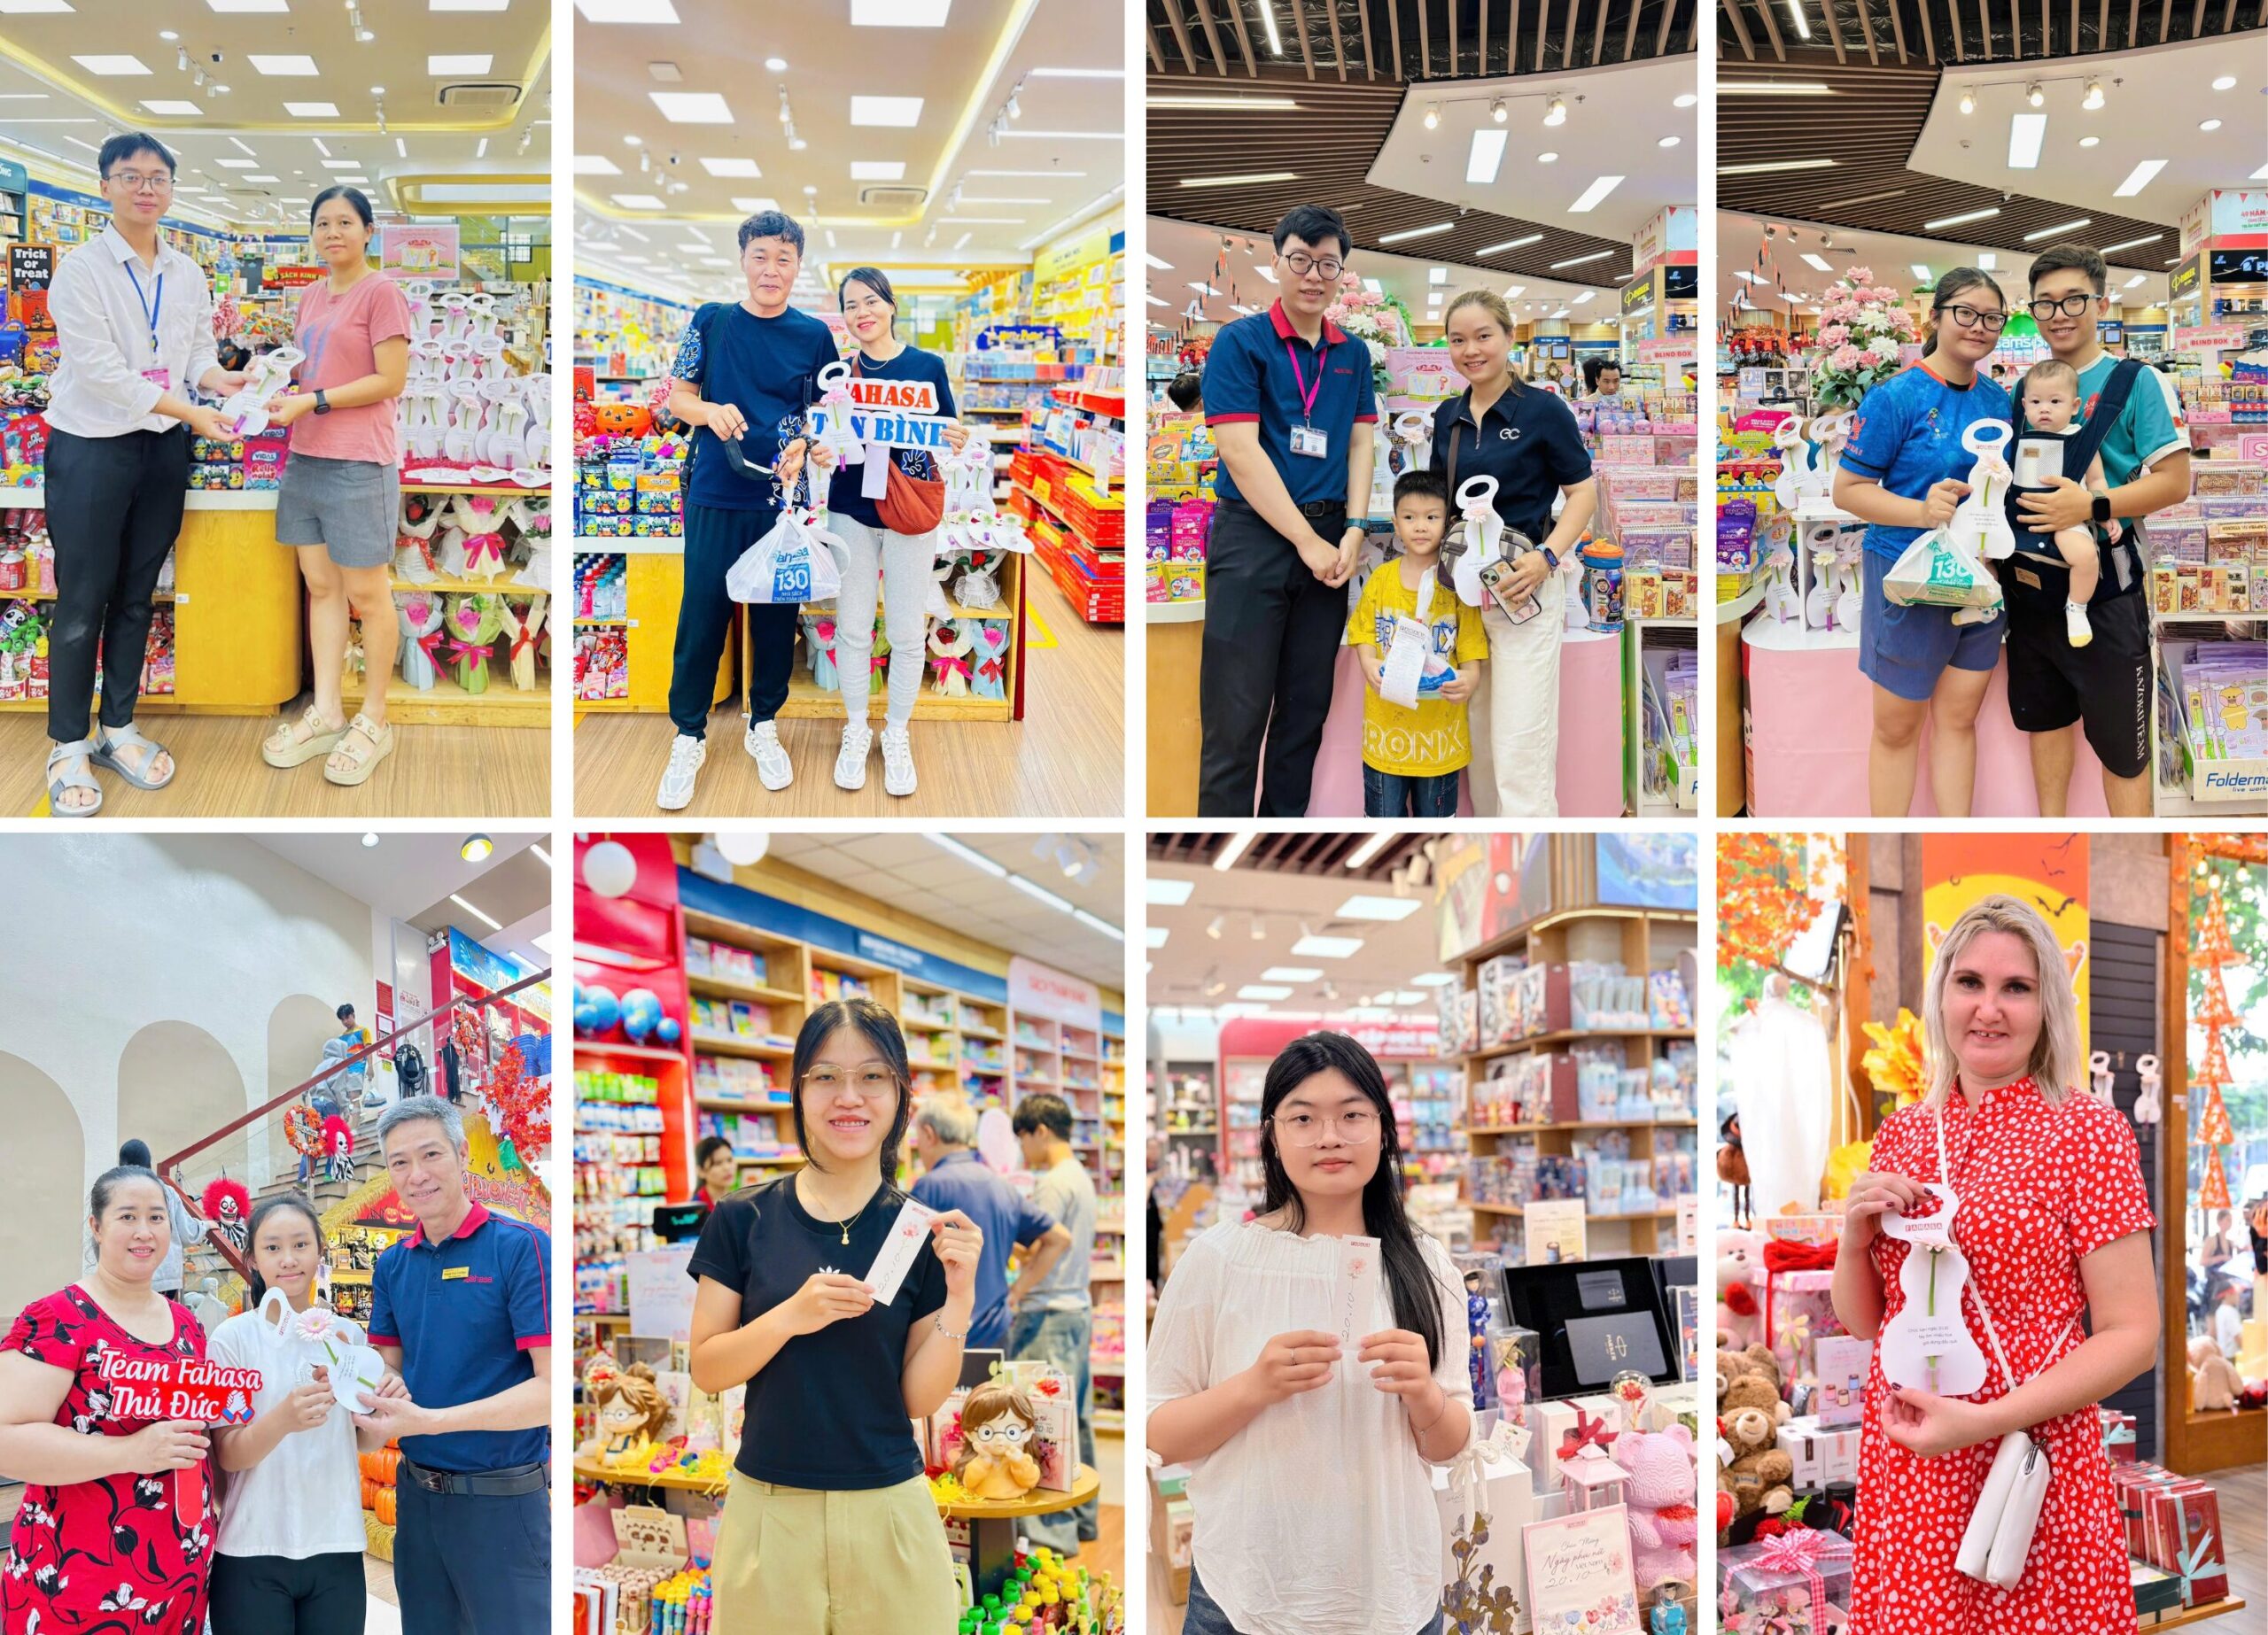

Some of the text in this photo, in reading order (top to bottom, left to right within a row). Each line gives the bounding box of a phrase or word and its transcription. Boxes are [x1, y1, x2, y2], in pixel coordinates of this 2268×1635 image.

[15, 248, 47, 259] Trick
[24, 260, 38, 268] or
[14, 268, 49, 279] Treat
[846, 383, 932, 408] AHASA
[812, 411, 866, 439] TN
[777, 569, 809, 591] 130
[2136, 666, 2146, 761] KAZOKU TEAM
[1906, 1222, 1942, 1232] FAHASA
[1606, 1335, 1616, 1361] PARKER
[177, 1359, 261, 1390] Fahasa
[113, 1387, 219, 1418] Thủ Đức
[1542, 1552, 1571, 1576] Ngày
[1545, 1571, 1590, 1589] 20.10
